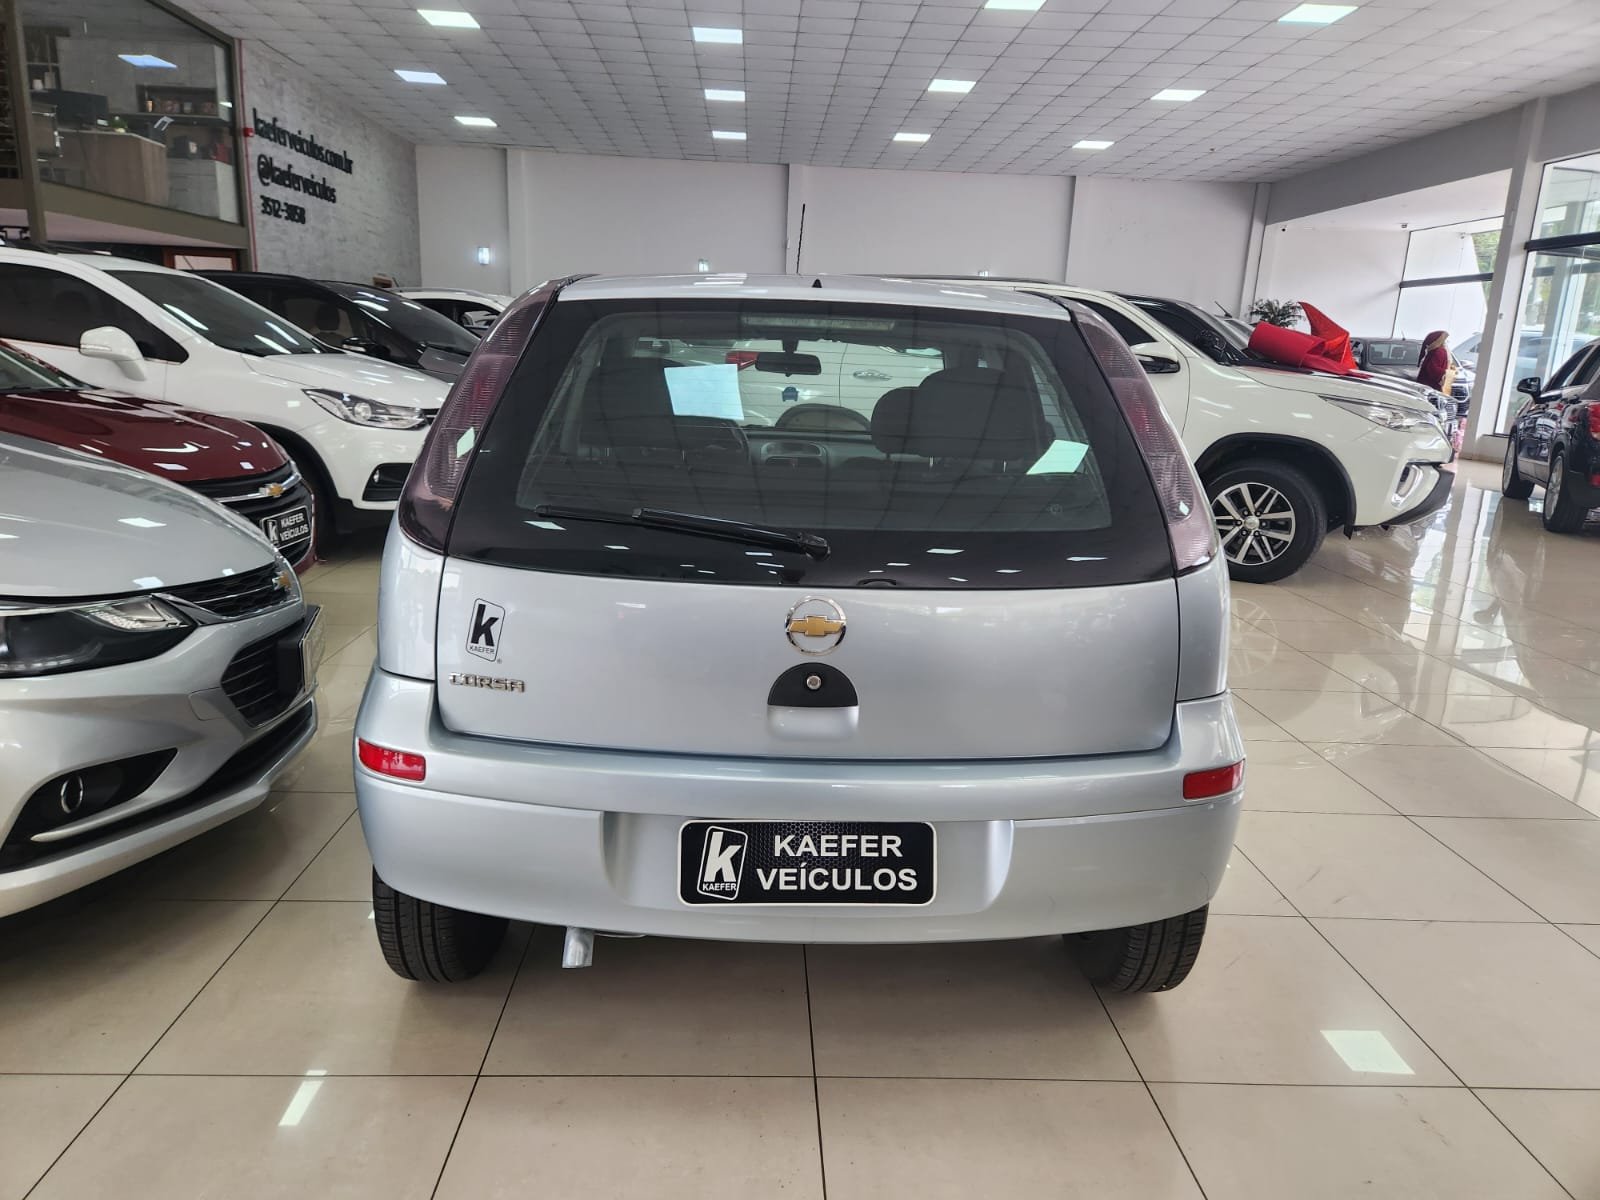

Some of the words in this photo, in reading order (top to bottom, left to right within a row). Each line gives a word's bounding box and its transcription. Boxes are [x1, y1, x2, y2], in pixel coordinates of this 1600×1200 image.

[257, 154, 336, 203] @kaeferveiculos
[281, 513, 304, 528] KAEFER
[469, 646, 495, 654] KAEFER
[449, 672, 525, 693] CORSA
[774, 834, 903, 857] KAEFER
[702, 883, 737, 891] KAEFER
[756, 862, 918, 891] VEÍCULOS
